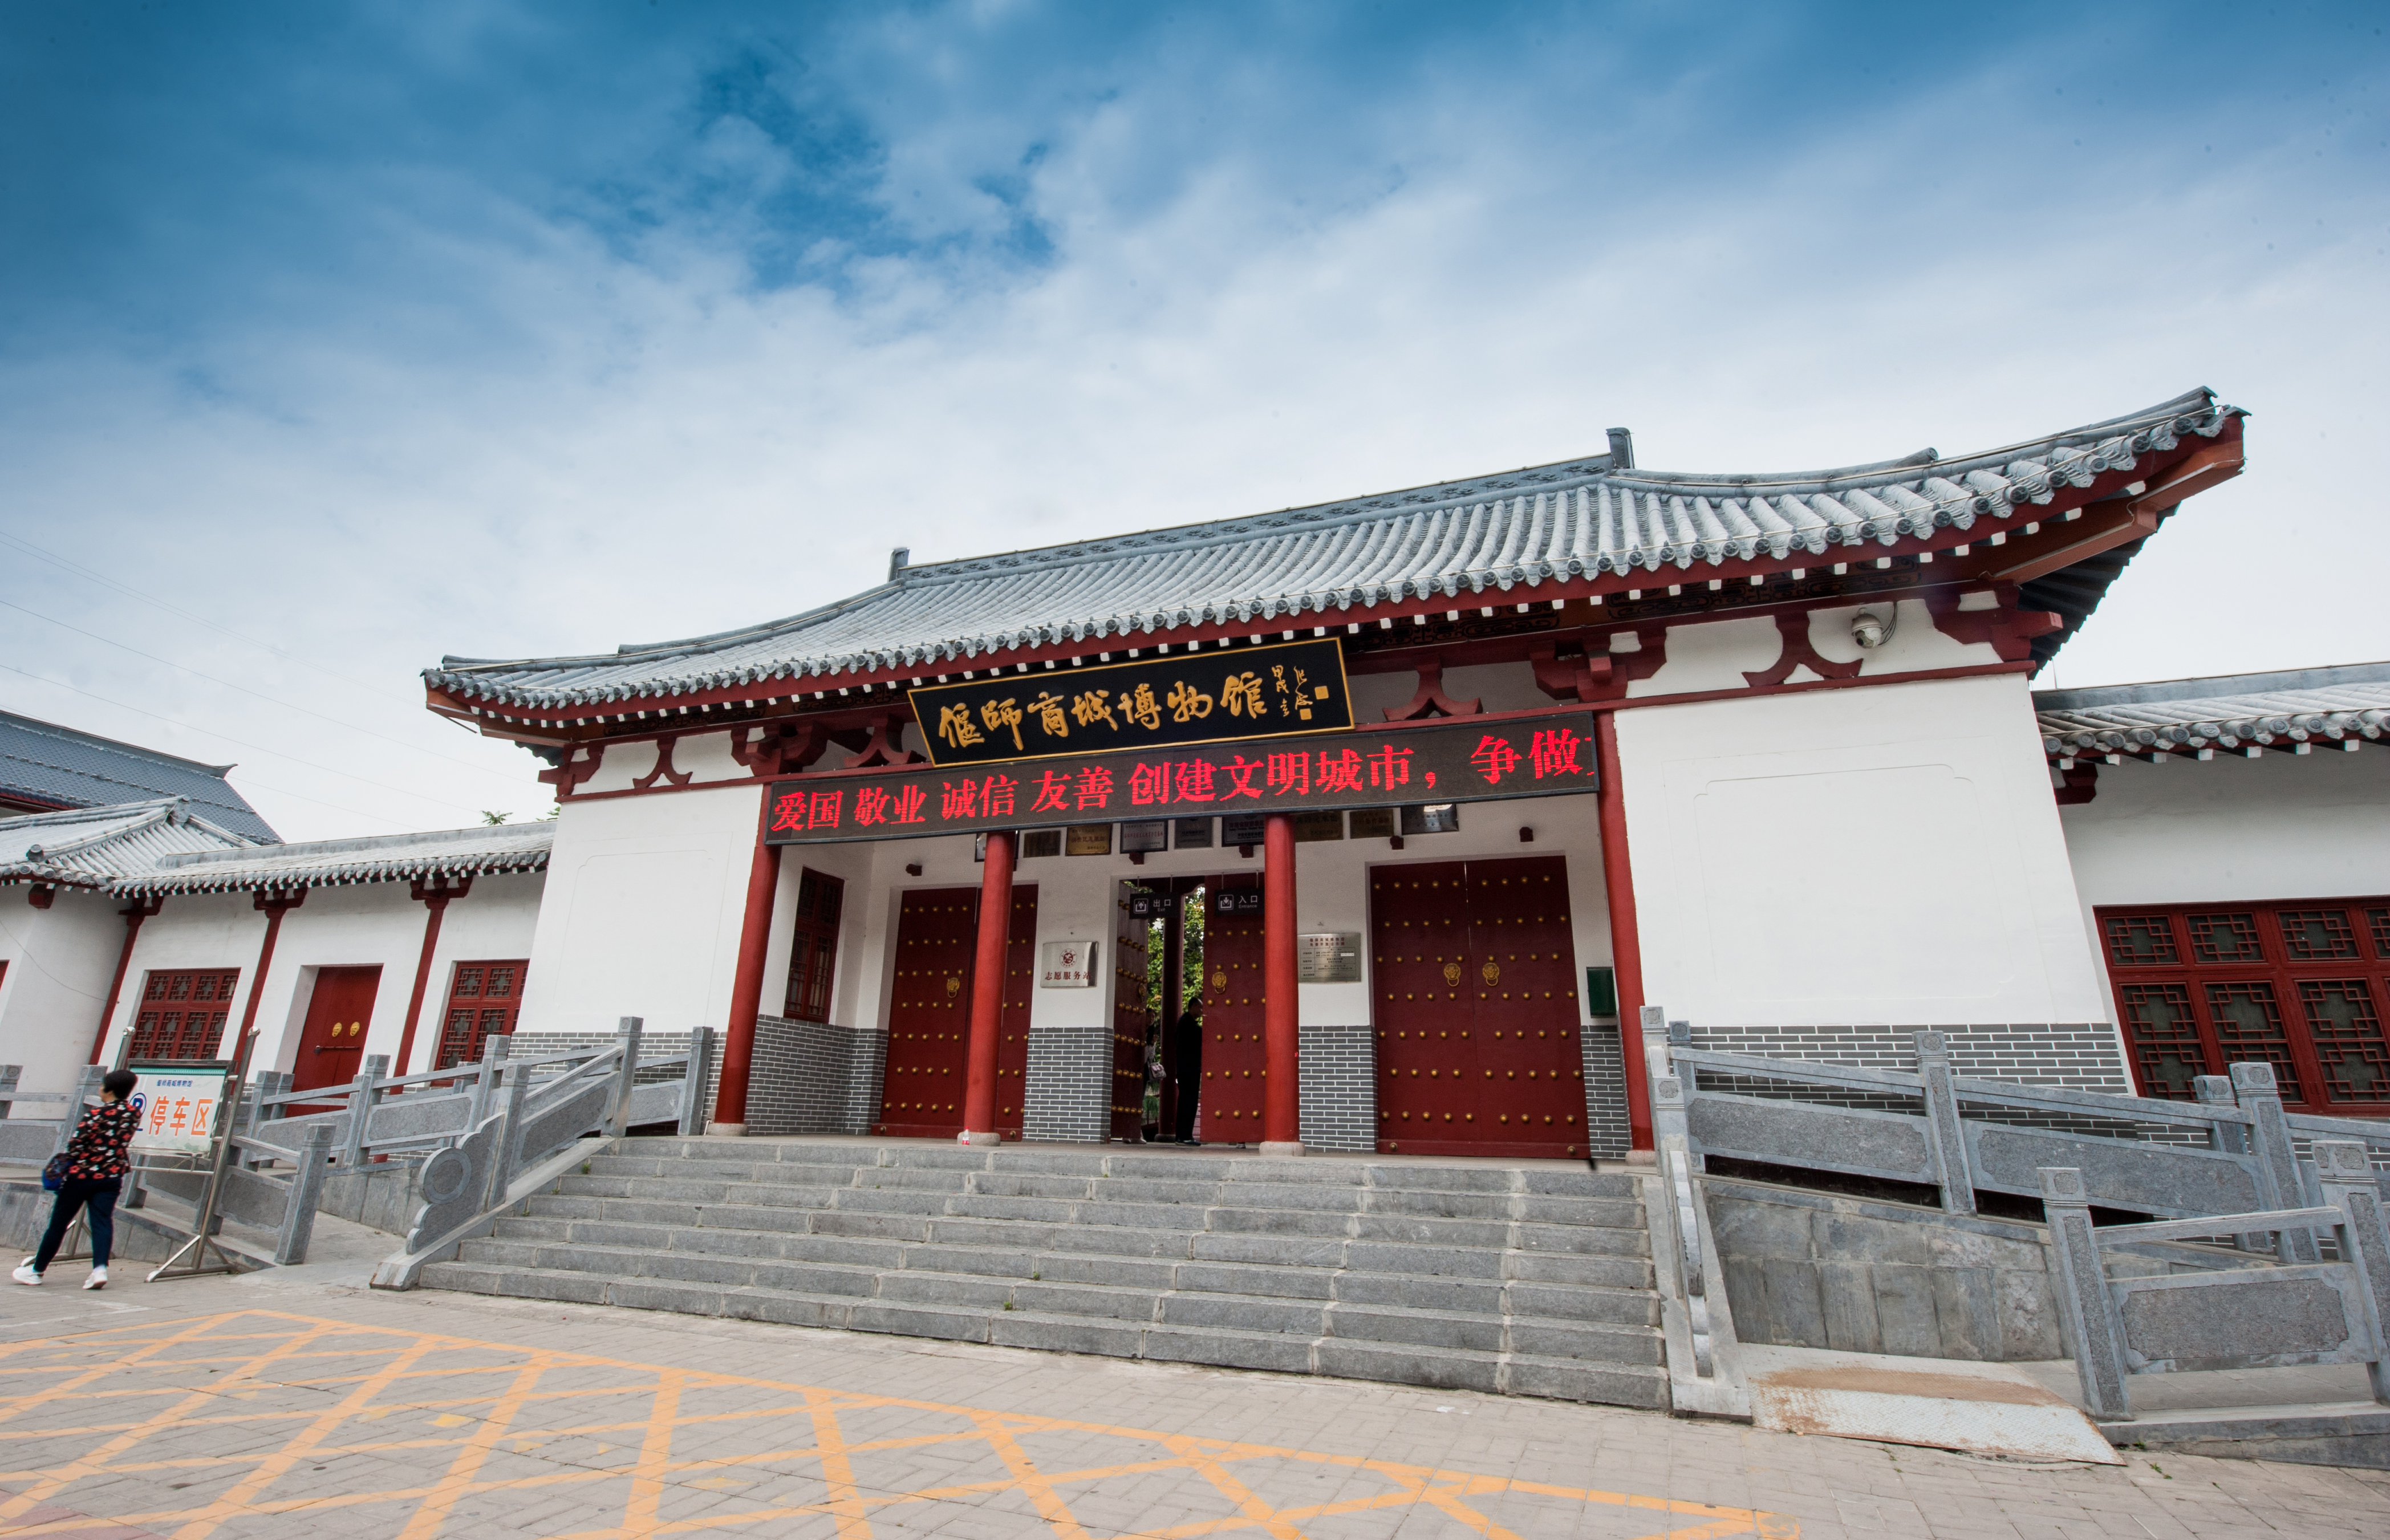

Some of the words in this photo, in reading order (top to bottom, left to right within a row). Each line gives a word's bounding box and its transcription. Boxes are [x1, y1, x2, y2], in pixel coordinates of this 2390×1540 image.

[772, 791, 843, 831] 爱国
[854, 785, 927, 826] 敬业
[941, 774, 1019, 820] 诚信
[1030, 766, 1113, 812] 友善
[1471, 729, 1594, 783] 争做
[1153, 899, 1171, 908] 出口
[1044, 971, 1091, 981] 志愿服务站
[148, 1096, 213, 1136] 停车区
